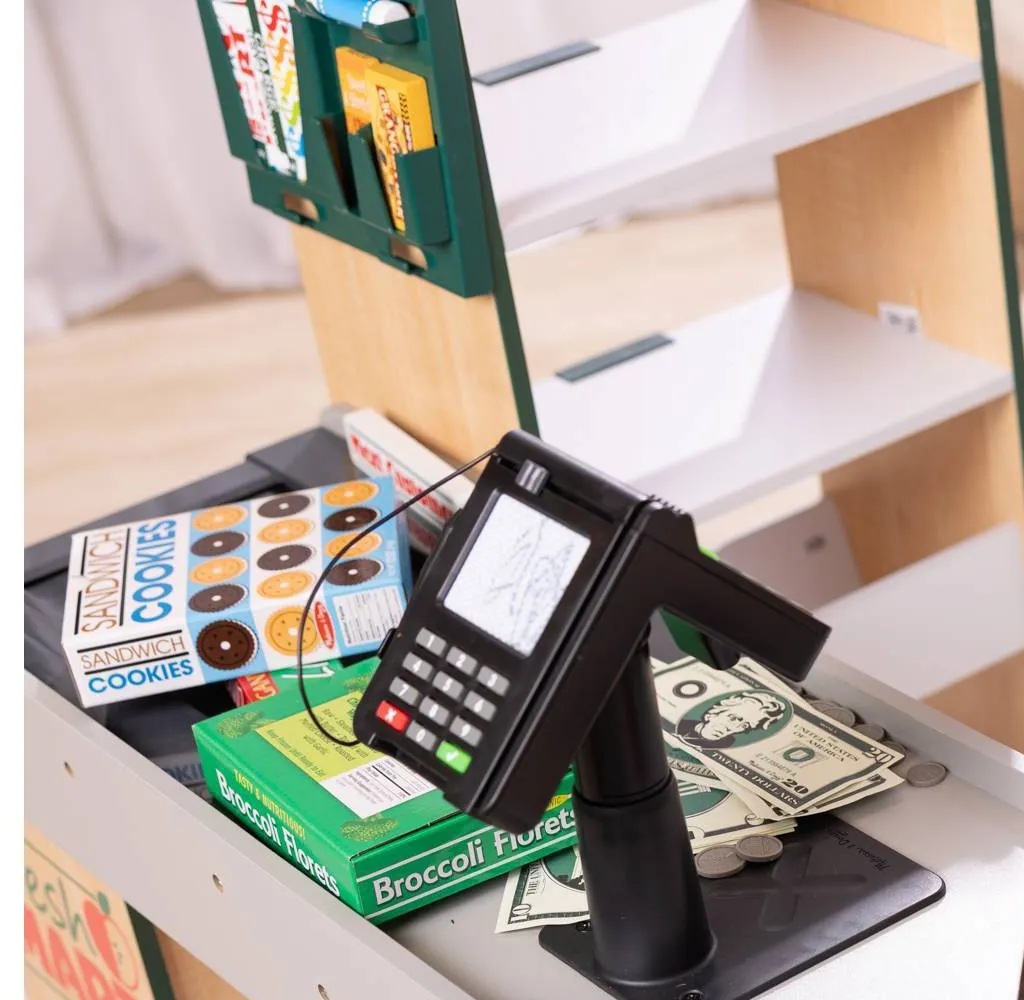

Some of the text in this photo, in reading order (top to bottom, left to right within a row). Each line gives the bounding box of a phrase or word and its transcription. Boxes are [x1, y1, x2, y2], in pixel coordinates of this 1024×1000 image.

[82, 529, 123, 633] SANDWICH
[131, 519, 176, 623] COOKIES
[81, 636, 186, 669] SANDWICH
[412, 660, 422, 672] 4
[426, 635, 435, 648] 1
[455, 654, 466, 668] 2
[88, 659, 194, 693] COOKIES
[398, 684, 409, 696] 7
[461, 723, 471, 737] 9
[415, 729, 426, 742] 0
[862, 746, 895, 764] 20
[712, 751, 749, 777] TWENTY
[751, 775, 798, 806] DOLLARS
[781, 779, 809, 794] 20
[233, 769, 253, 793] TASTY
[262, 794, 306, 840] NUTRITIOUS!
[215, 768, 281, 846] Broccoli
[282, 827, 340, 897] Florets
[372, 838, 485, 906] Broccoli
